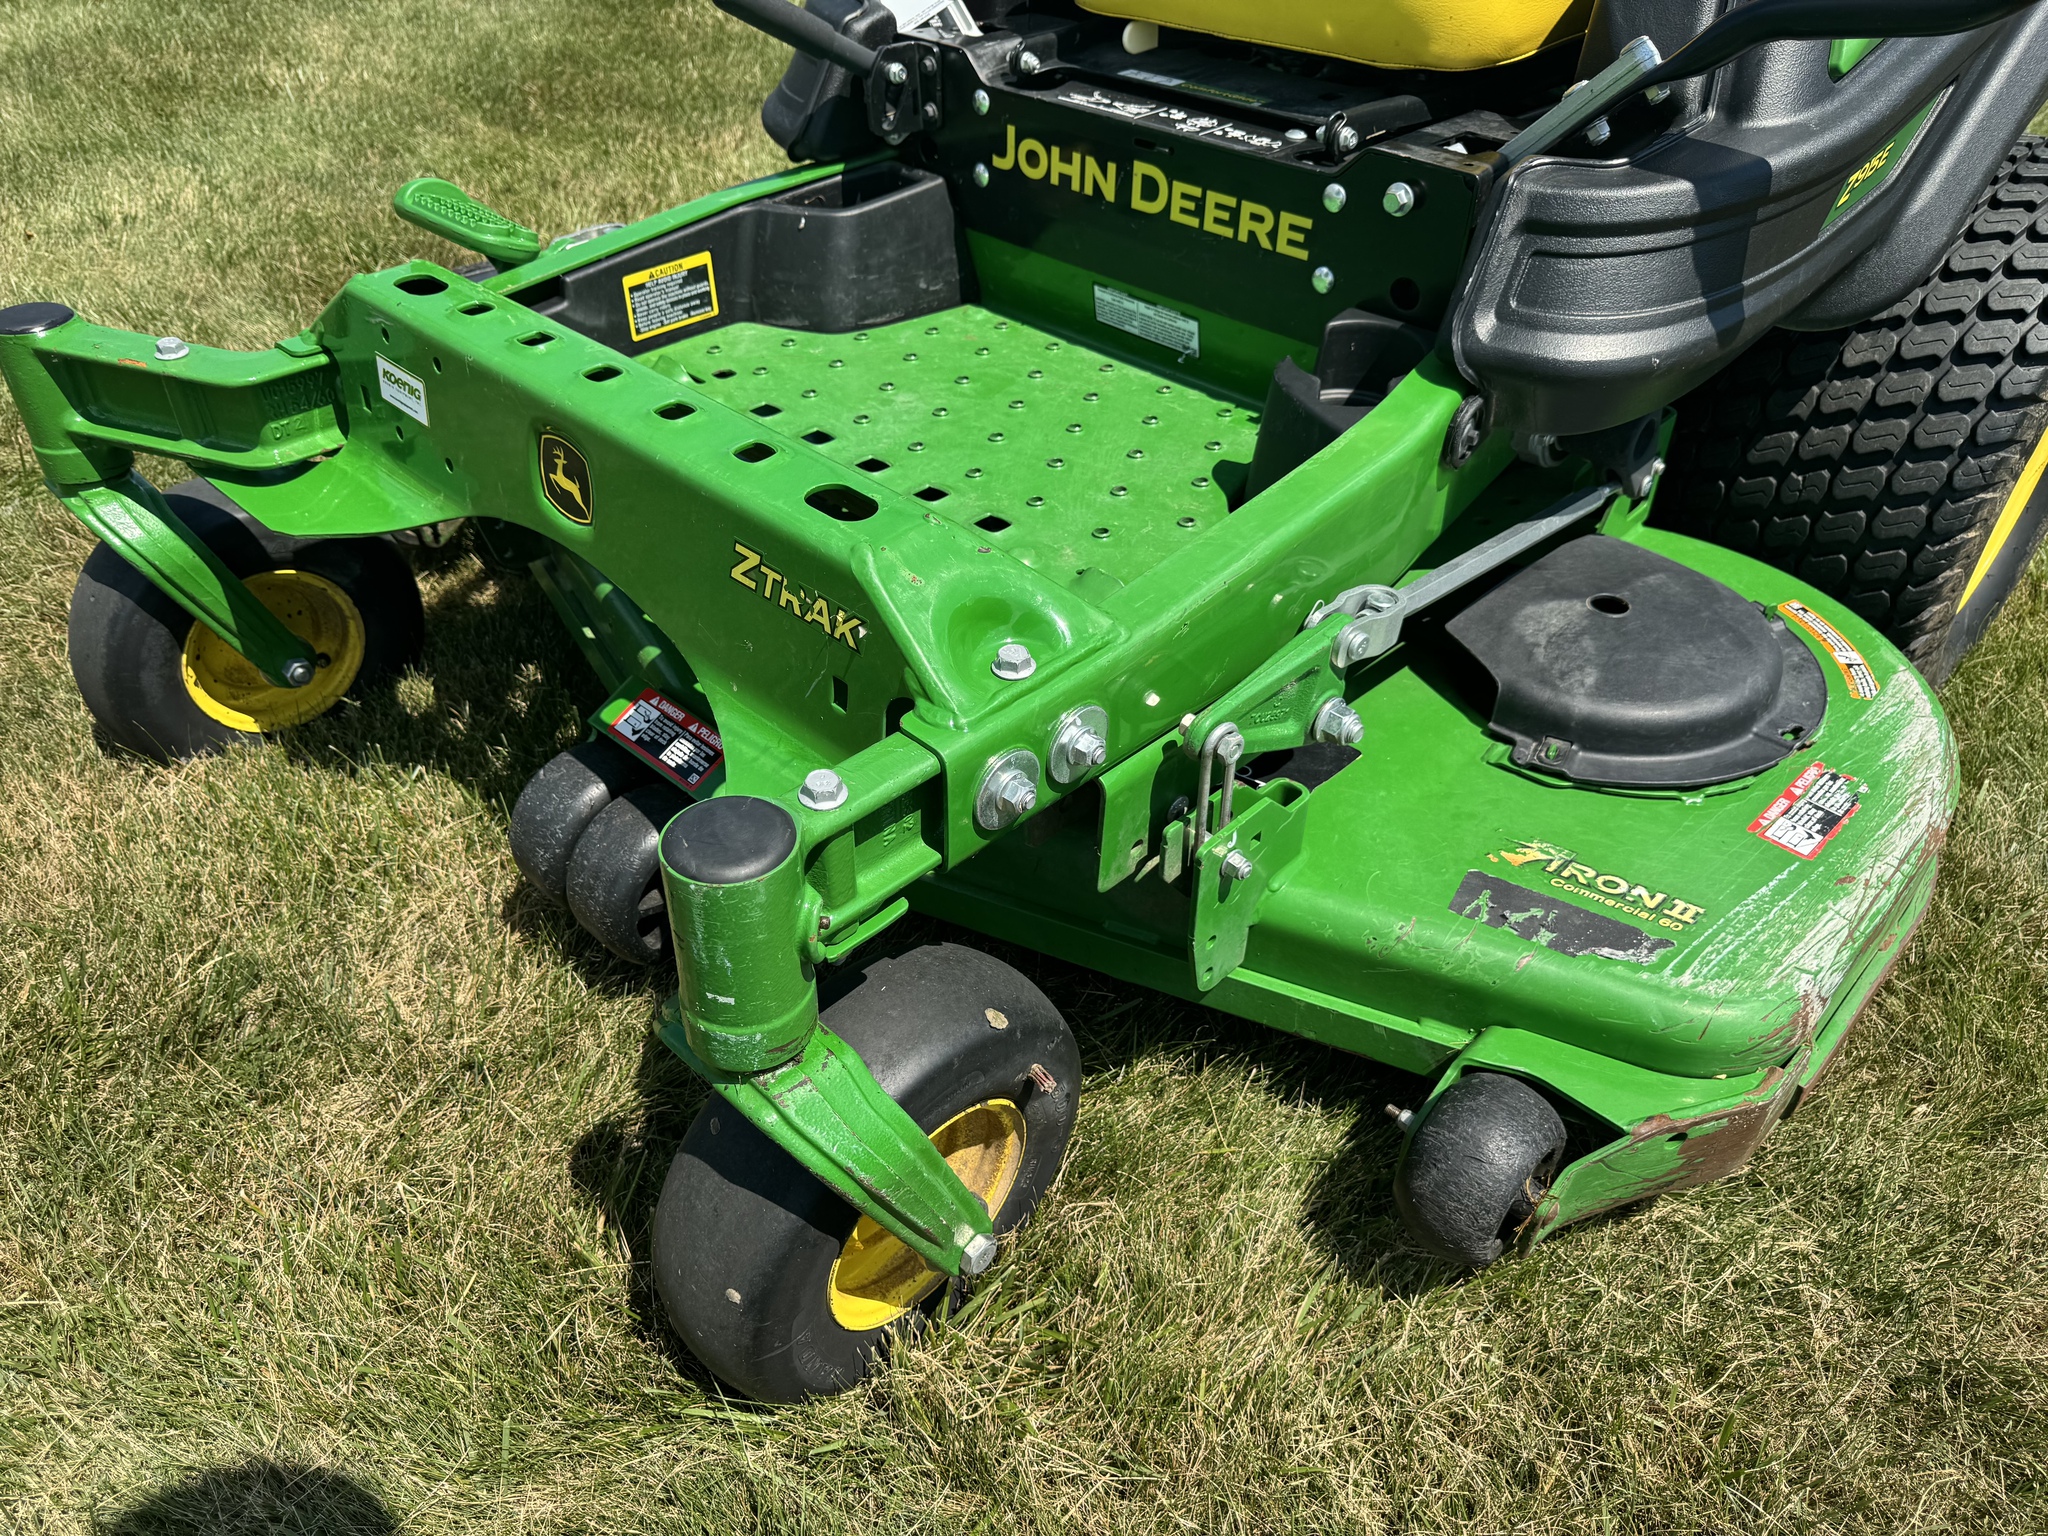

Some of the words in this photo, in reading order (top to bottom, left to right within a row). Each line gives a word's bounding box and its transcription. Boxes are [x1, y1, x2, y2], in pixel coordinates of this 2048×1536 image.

[992, 124, 1116, 203] JOHN
[1131, 160, 1313, 261] DEERE
[654, 262, 683, 277] CAUTION
[658, 700, 685, 721] DANGER
[697, 727, 724, 750] PELIGRO
[1550, 878, 1656, 922] Commercial
[1658, 916, 1684, 932] 60
[1663, 897, 1707, 925] II
